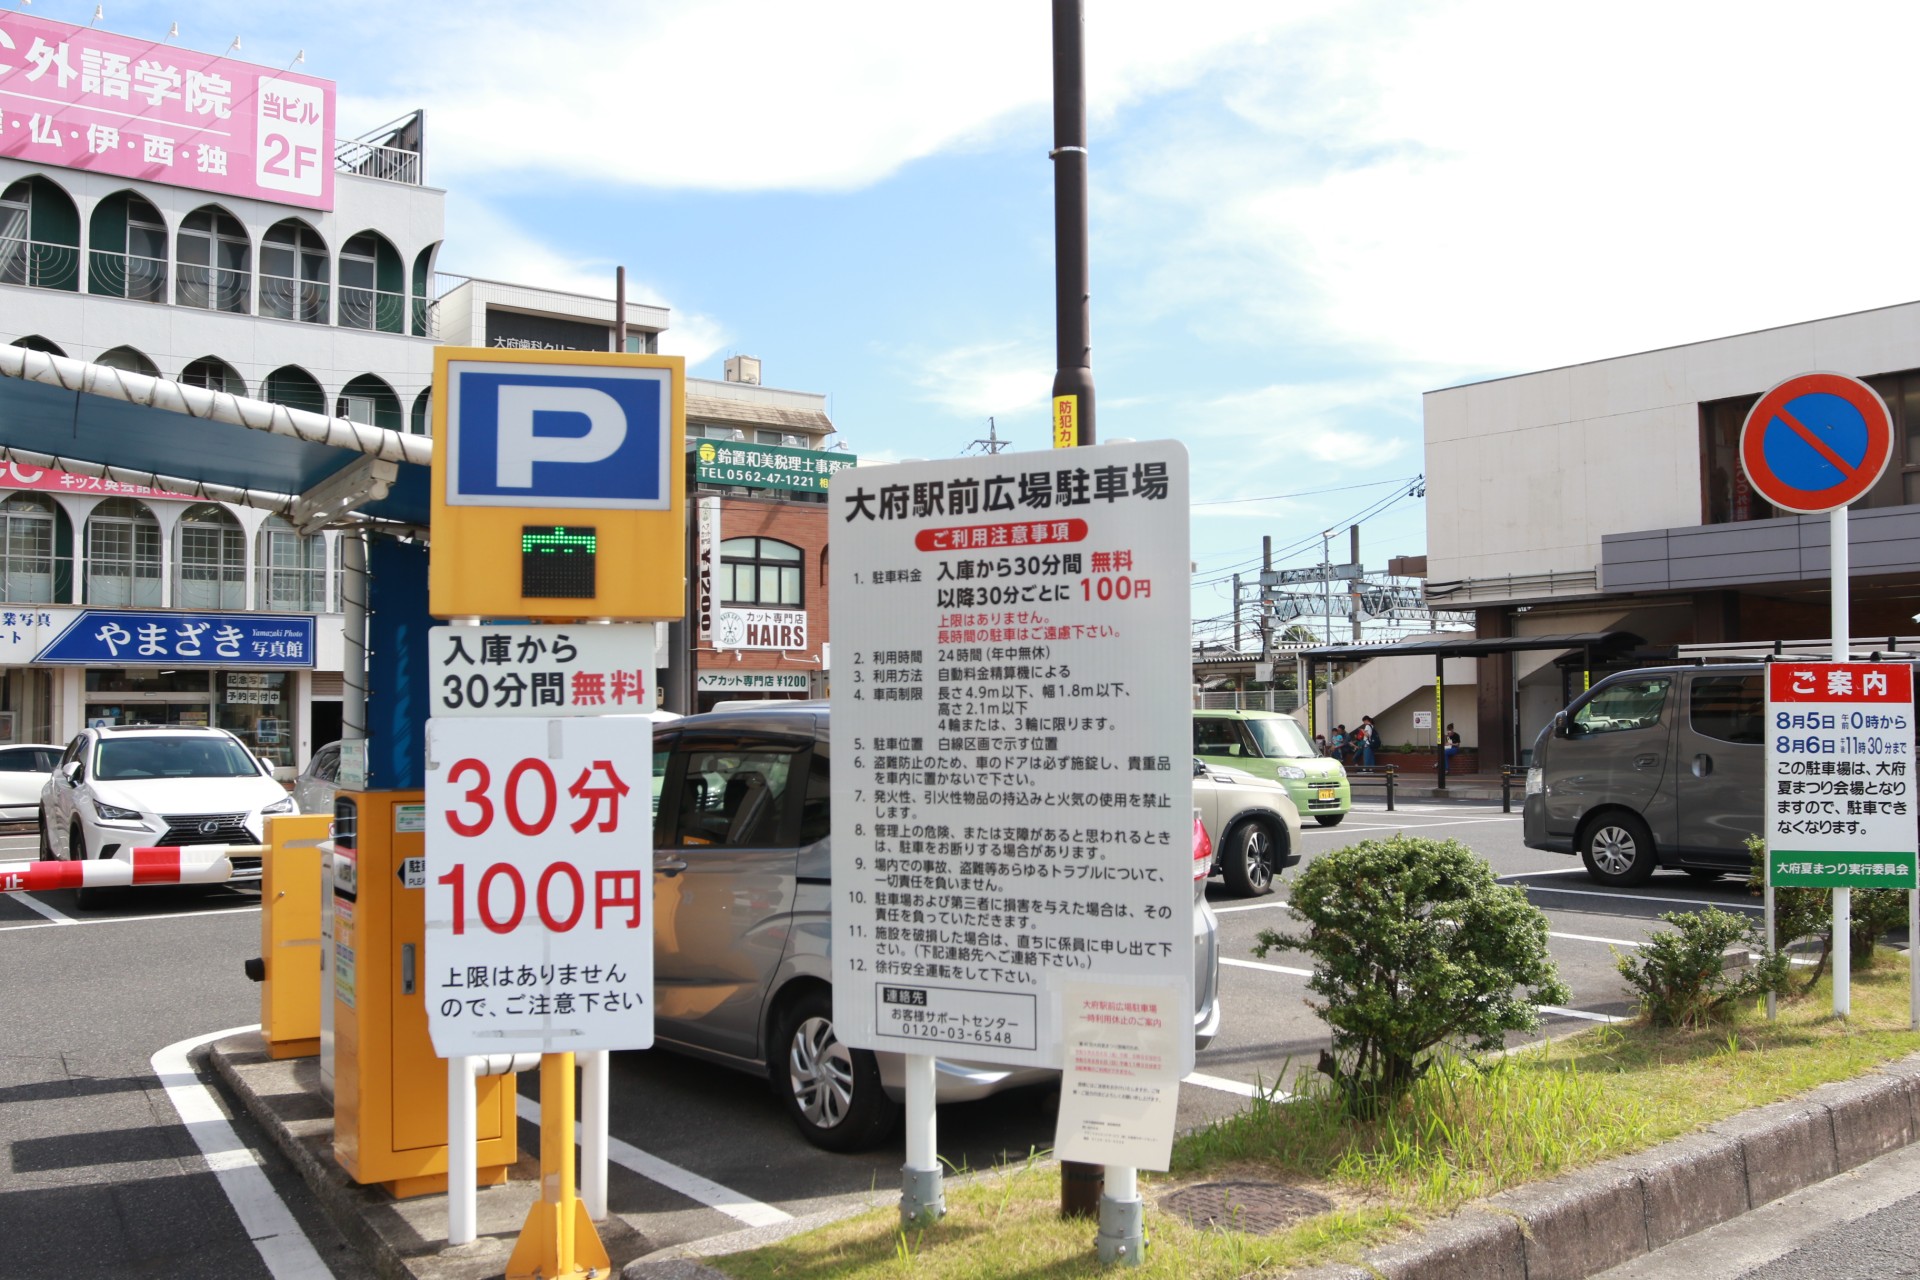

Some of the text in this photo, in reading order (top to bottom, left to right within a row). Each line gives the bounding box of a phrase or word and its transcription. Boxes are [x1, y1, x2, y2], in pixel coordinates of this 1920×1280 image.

[25, 36, 231, 119] 外語学院
[263, 92, 320, 127] 当ビル
[0, 107, 227, 176] ・仏・伊・西・独
[263, 133, 315, 178] 2F
[1059, 400, 1072, 448] 防犯カ
[496, 384, 628, 488] P
[845, 461, 1169, 523] 大府駅前広場駐車場
[933, 521, 1069, 548] ご利用注意事項
[854, 550, 1133, 584] 1. 駐車料金 入庫から30分間 無料
[937, 576, 1151, 609] 以降30分ごとに 100円
[747, 612, 803, 625] カット専門店
[937, 611, 1050, 628] 上限はありません。
[95, 622, 245, 658] やまざき
[252, 628, 303, 638] Yamazaki Photo
[747, 624, 804, 647] HAIRS
[938, 625, 1120, 644] 長時間の駐車はご遠慮下さい。
[251, 640, 303, 658] 写真館
[443, 634, 577, 666] 入庫から
[854, 653, 865, 664] 2.
[873, 651, 922, 665] 利用時間
[228, 673, 268, 686] 記念写真
[698, 675, 806, 688] ヘアカット専門店 ¥1200
[854, 665, 1070, 683] 3. 利用方法 自動料金精算機による
[1792, 671, 1887, 696] ご案内
[228, 690, 280, 704] 予約受付中
[854, 689, 865, 701] 4.
[873, 687, 923, 701] 車両制限
[938, 702, 1028, 717] 高さ2.1m以下
[938, 717, 1116, 732] 4輪または、3輪に限ります。
[854, 737, 1058, 751] 5. 駐車位置 白線区画で示す位置
[854, 756, 1171, 771] 6. 盗難防止のため、車のドアは必ず施錠し、貴重品
[1778, 761, 1906, 776] この駐車場は、大府
[875, 772, 1035, 787] を車内に置かないで下さい。
[1778, 780, 1906, 796] 夏まつり会場となり
[445, 757, 631, 837] 30分
[855, 790, 1171, 808] 7. 発火性、引火性物品の持込みと火気の使用を禁止
[876, 806, 917, 820] します。
[1778, 800, 1907, 816] ますので、駐車でき
[855, 824, 1171, 845] 8. 管理上の危険、または支障があると思われるとき
[1778, 820, 1867, 835] なくなります。
[875, 840, 1105, 860] は、駐車をお断りする場合があります。
[855, 858, 1164, 882] 9. 場内での事故、盗難等あらゆるトラブルについて、
[1777, 862, 1909, 877] 大府夏まつり実行委員会
[875, 874, 1003, 893] 一切責任を負いません。
[438, 861, 641, 935] 100円
[849, 891, 1172, 919] 10. 駐車場および第三者に損害を与えた場合は、その
[876, 908, 1036, 930] 責任を負っていただきます。
[849, 925, 1172, 957] 11. 施設を破損した場合は、直ちに係員に申し出て下
[441, 964, 626, 989] 上限はありません
[850, 959, 1037, 985] 12. 徐行安全運転をして下さい。
[441, 990, 643, 1018] ので、ご注意下さい
[886, 989, 925, 1005] 連絡先
[891, 1008, 1019, 1029] お客様サポートセンター
[902, 1023, 1012, 1044] 0120-03-6548
